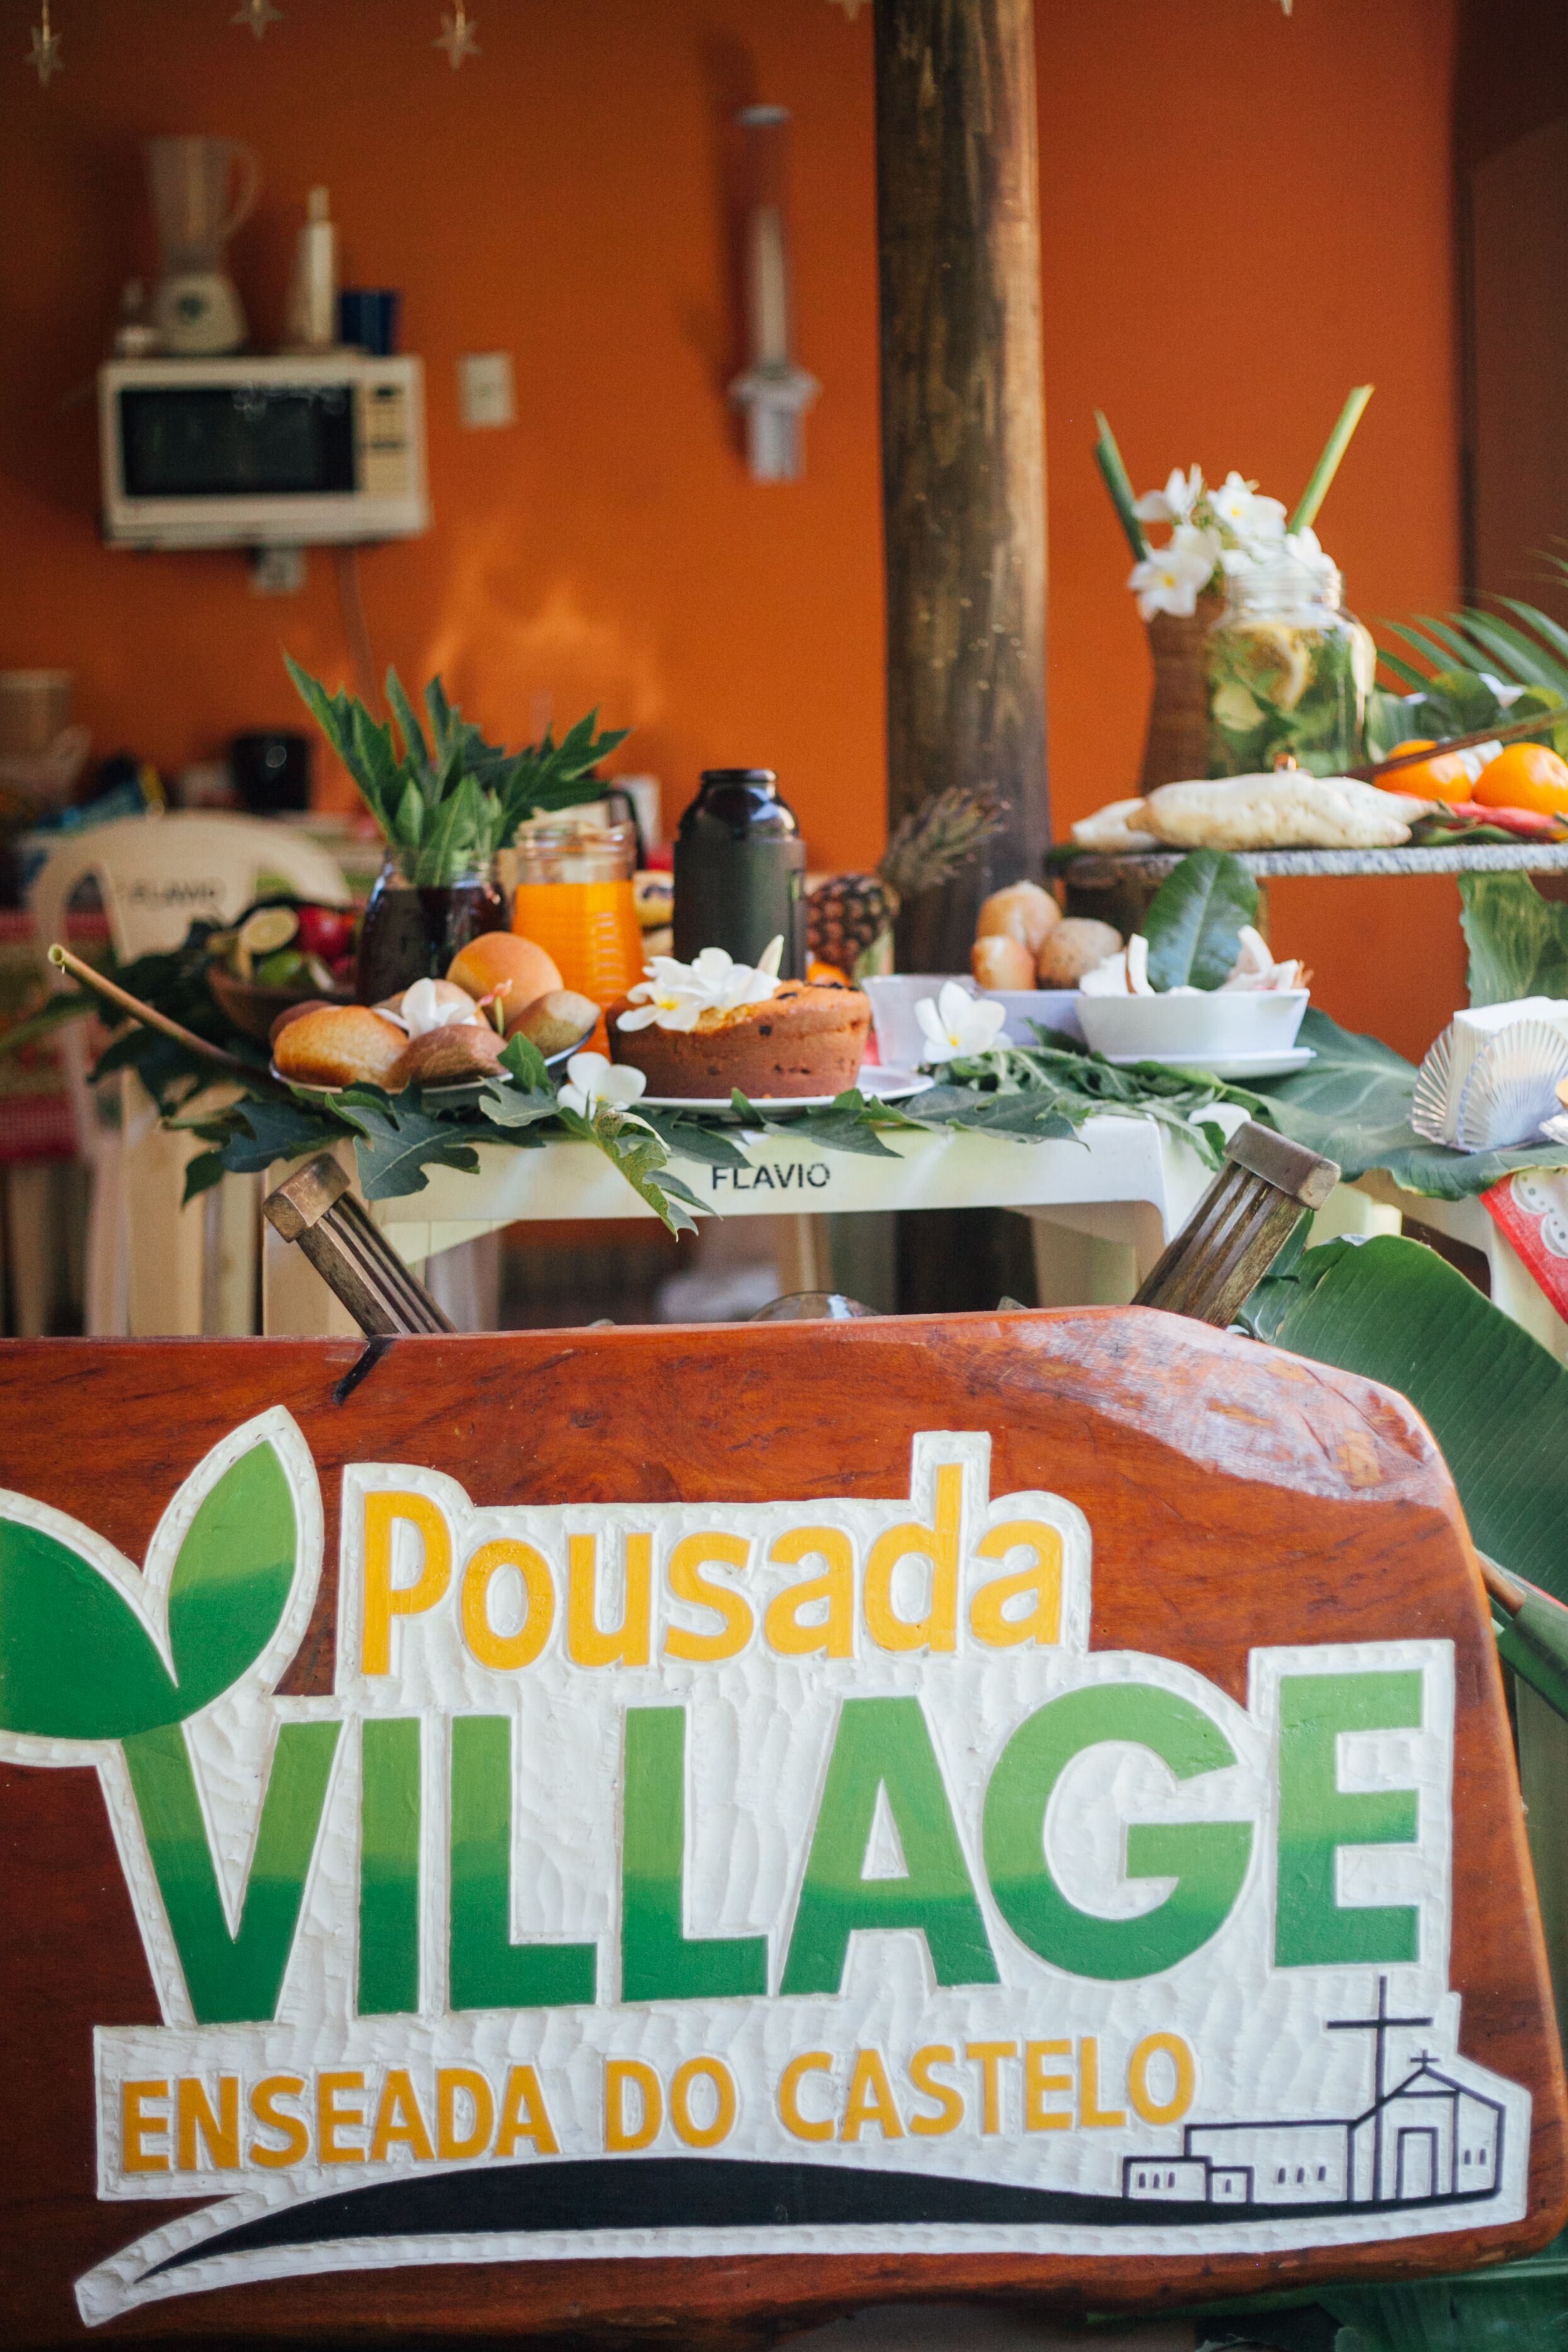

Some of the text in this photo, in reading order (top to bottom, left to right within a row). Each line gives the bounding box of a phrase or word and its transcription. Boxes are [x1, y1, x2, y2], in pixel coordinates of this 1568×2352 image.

[712, 1163, 830, 1190] FLAVIO
[361, 1463, 1064, 1675] Pousada
[121, 1668, 1424, 2025] VILLAGE
[122, 2031, 1195, 2173] ENSEADA DO CASTELO
